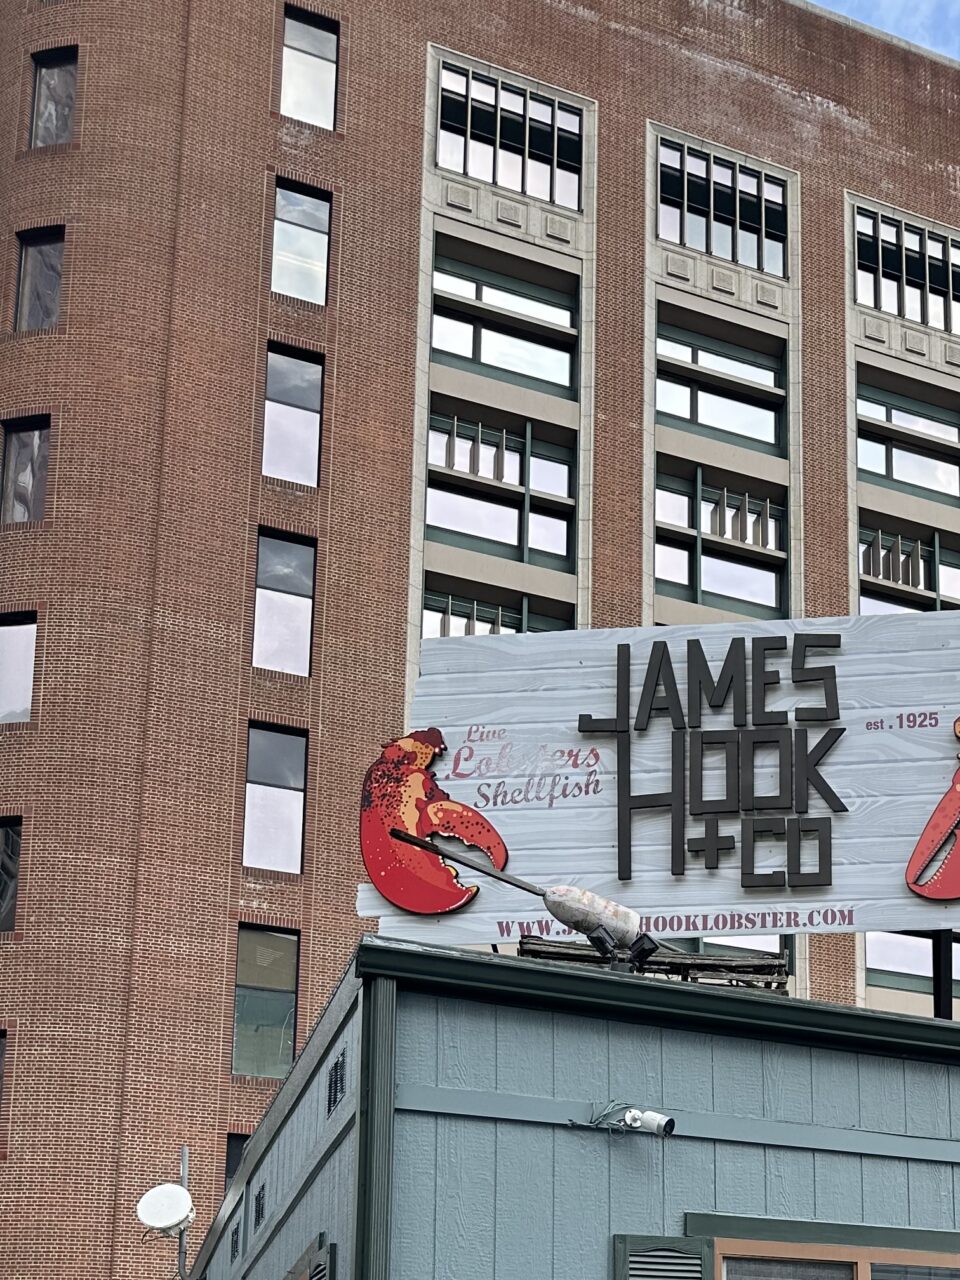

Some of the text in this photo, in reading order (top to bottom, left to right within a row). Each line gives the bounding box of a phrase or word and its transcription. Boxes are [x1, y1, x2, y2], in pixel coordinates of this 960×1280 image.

[578, 633, 841, 732] JAMES
[463, 724, 507, 743] Live
[896, 712, 939, 729] 1925
[452, 742, 600, 778] Lobers
[474, 769, 603, 809] Shellfish
[617, 728, 849, 880] HOOK
